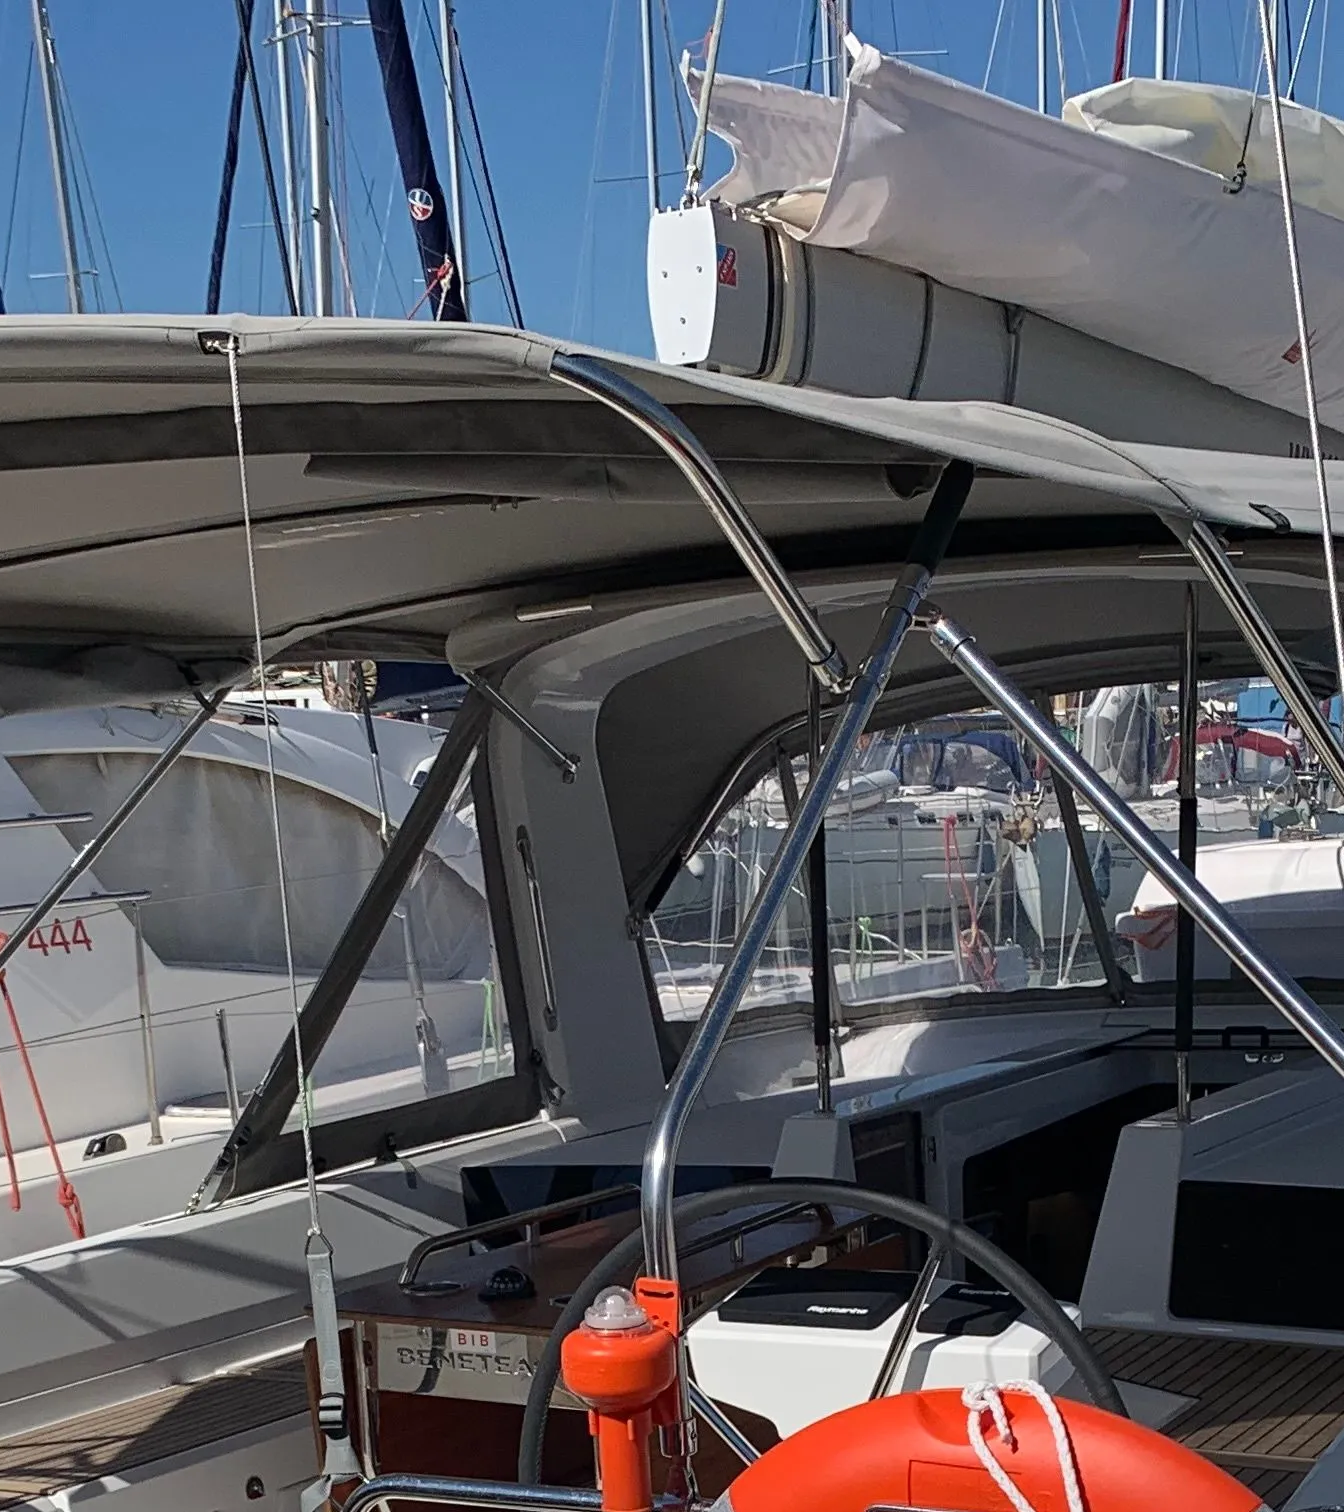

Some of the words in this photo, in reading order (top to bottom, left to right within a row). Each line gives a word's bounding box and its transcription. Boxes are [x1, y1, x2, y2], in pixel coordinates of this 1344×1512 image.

[27, 916, 93, 957] 444
[806, 1305, 869, 1315] Raymarine
[396, 1347, 540, 1377] BENETEA
